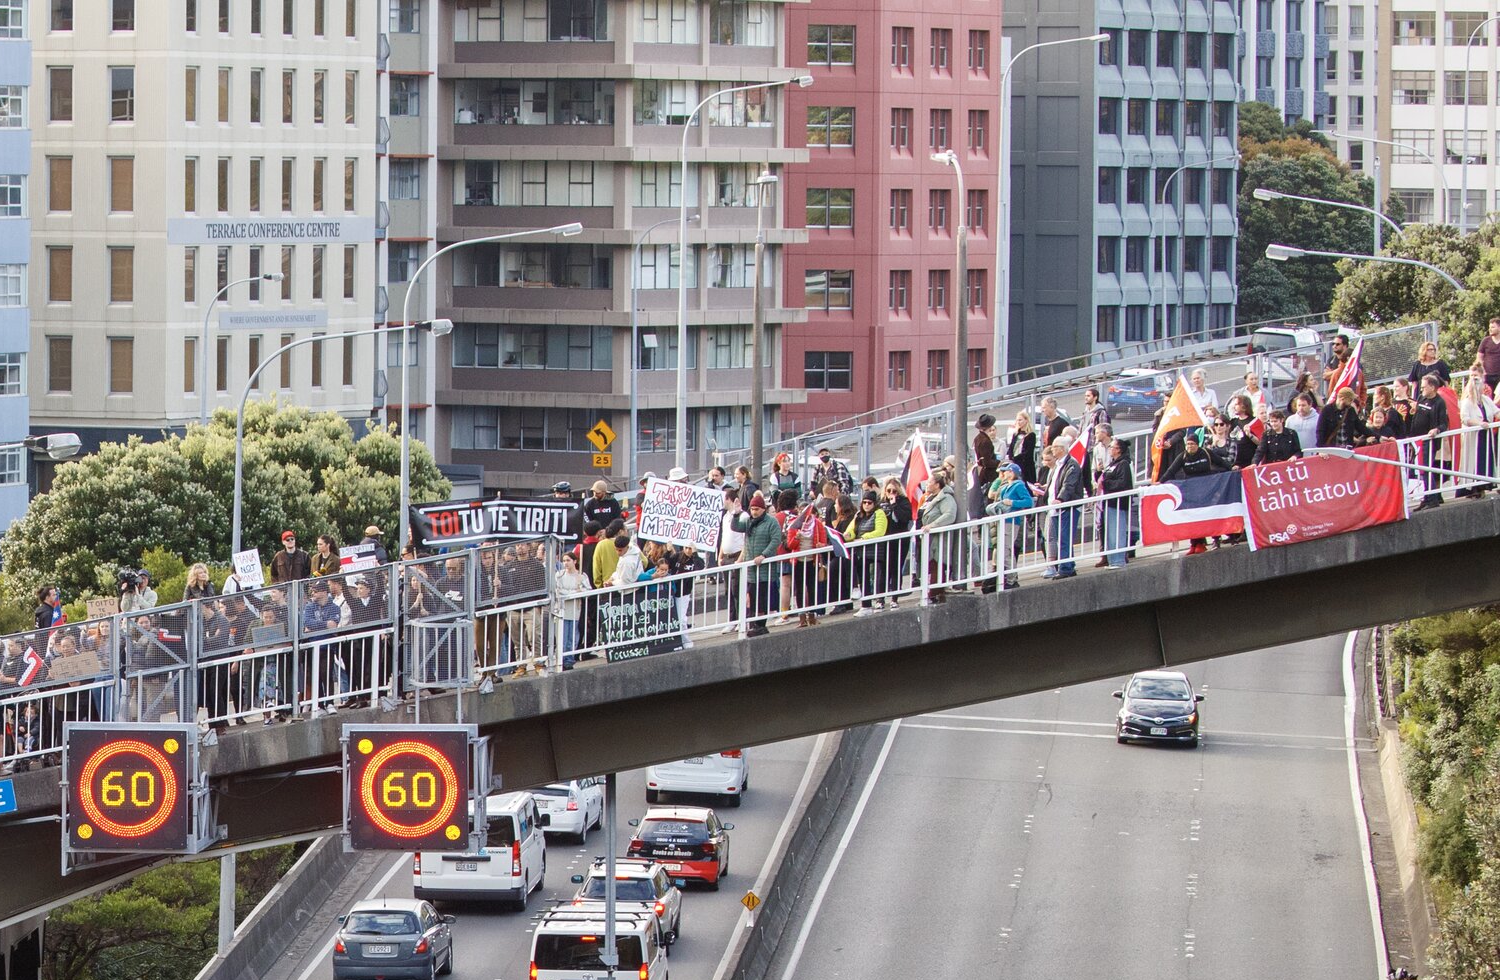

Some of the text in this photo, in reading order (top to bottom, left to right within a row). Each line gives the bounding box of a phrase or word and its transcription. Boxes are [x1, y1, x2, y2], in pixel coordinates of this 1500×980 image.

[206, 222, 340, 238] TERRACE CONFERENCE CENTRE
[596, 456, 609, 465] 25
[1254, 461, 1309, 488] Ka tū
[687, 491, 724, 512] MANA
[1258, 480, 1360, 512] tāhi tatou
[488, 506, 509, 531] TE
[513, 507, 568, 533] TIRITI
[691, 512, 720, 528] MANA
[1268, 531, 1290, 544] PSA
[240, 563, 256, 573] NOT
[102, 771, 155, 806] 60
[383, 771, 436, 807] 60
